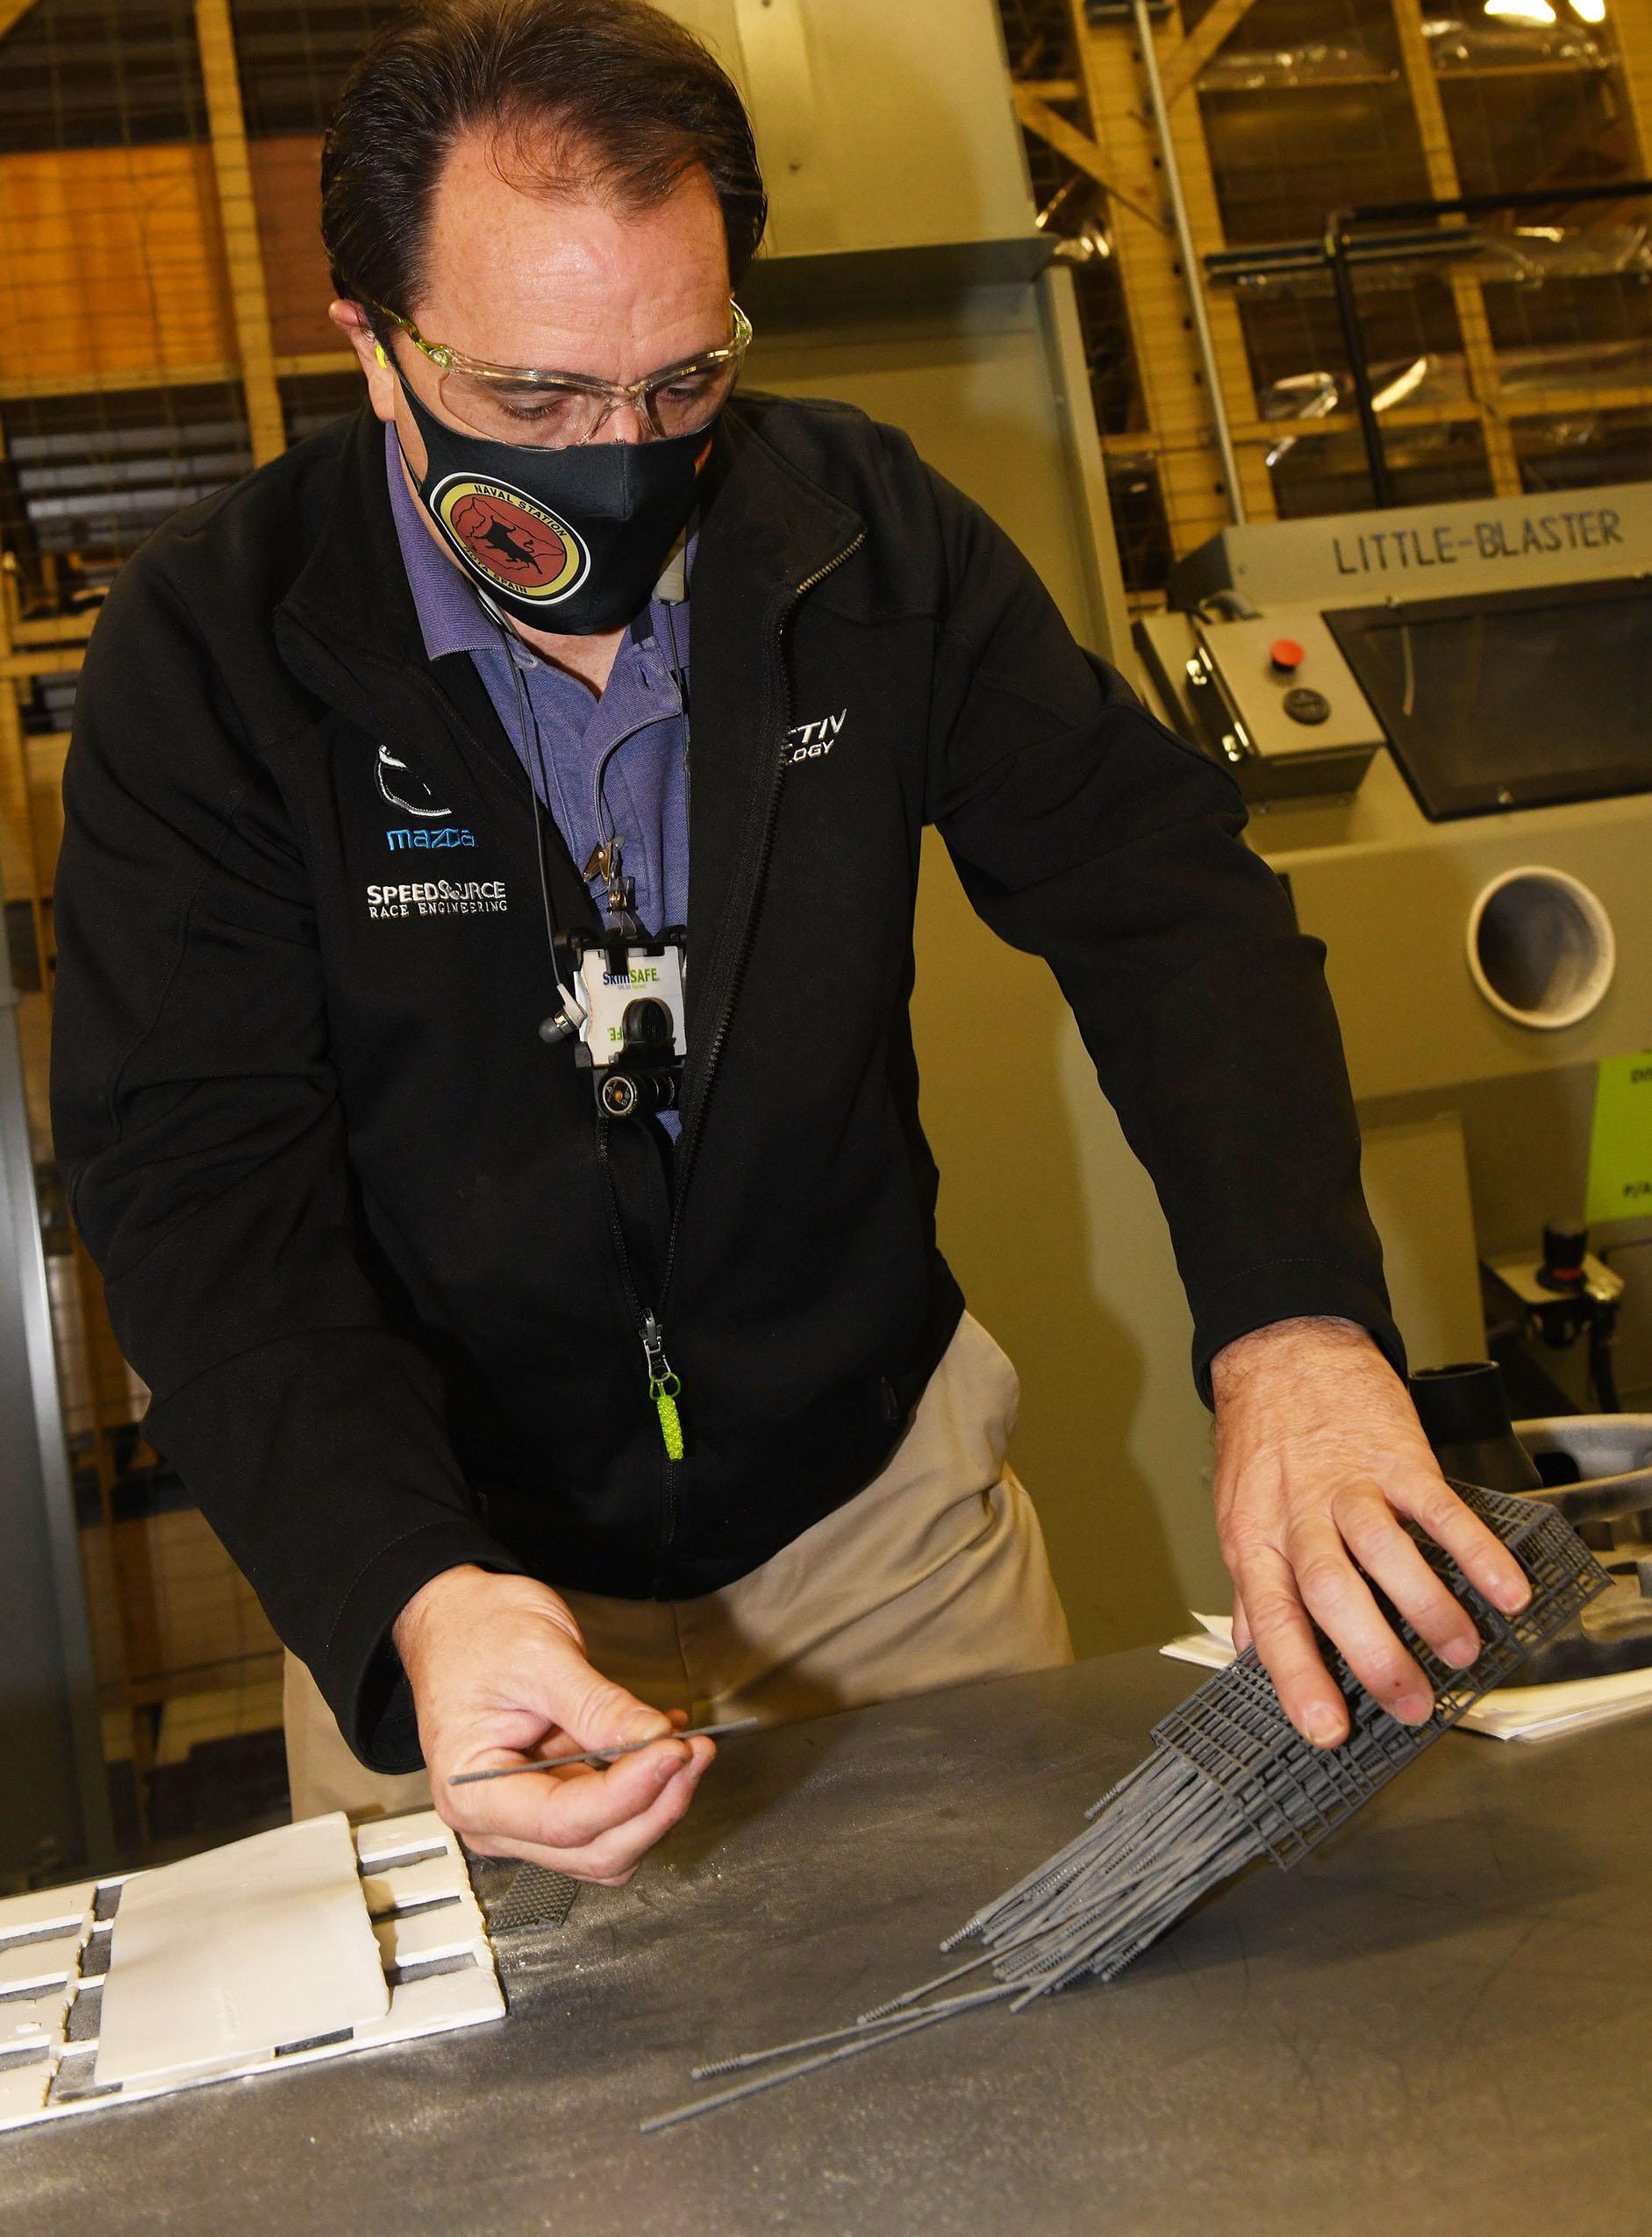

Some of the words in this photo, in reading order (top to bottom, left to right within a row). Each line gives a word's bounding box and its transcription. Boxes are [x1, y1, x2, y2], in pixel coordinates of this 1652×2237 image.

[474, 484, 514, 504] NAVAL
[518, 500, 569, 537] STATION
[1332, 507, 1624, 575] LITTLE-BLASTER
[788, 739, 835, 763] OGY
[386, 827, 476, 851] mazda
[368, 904, 410, 919] RACE
[418, 900, 508, 917] ENGINEERING
